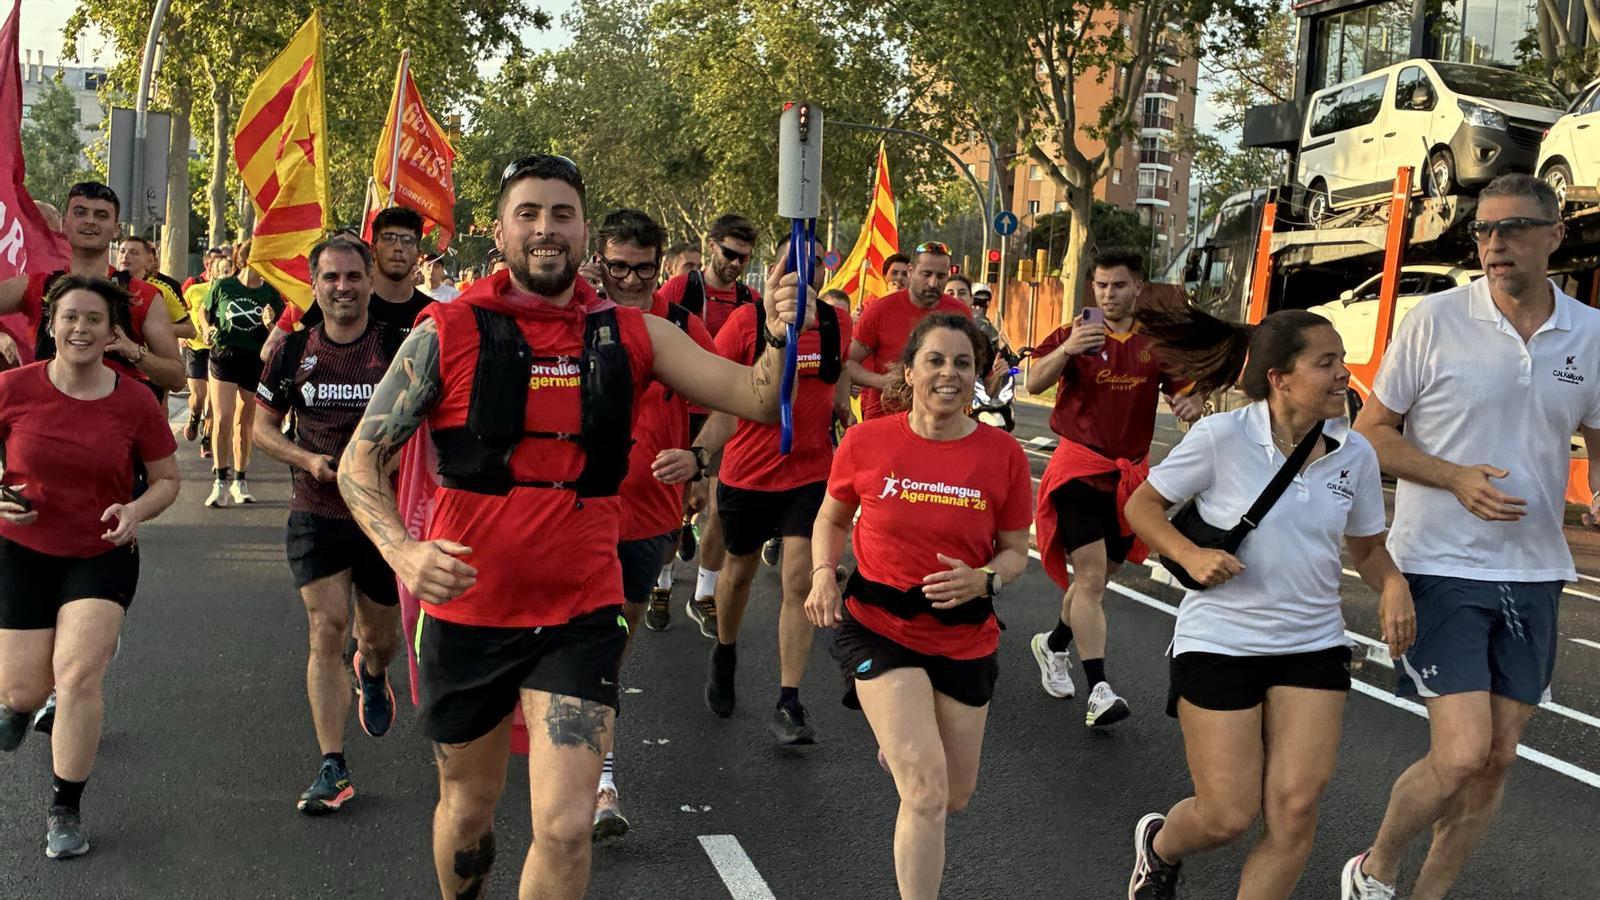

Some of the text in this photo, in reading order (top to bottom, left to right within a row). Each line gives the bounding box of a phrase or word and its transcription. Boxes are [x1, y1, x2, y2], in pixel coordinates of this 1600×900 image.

[529, 376, 582, 390] germa
[901, 478, 982, 499] Correllengua
[900, 489, 988, 511] Agermanat '26
